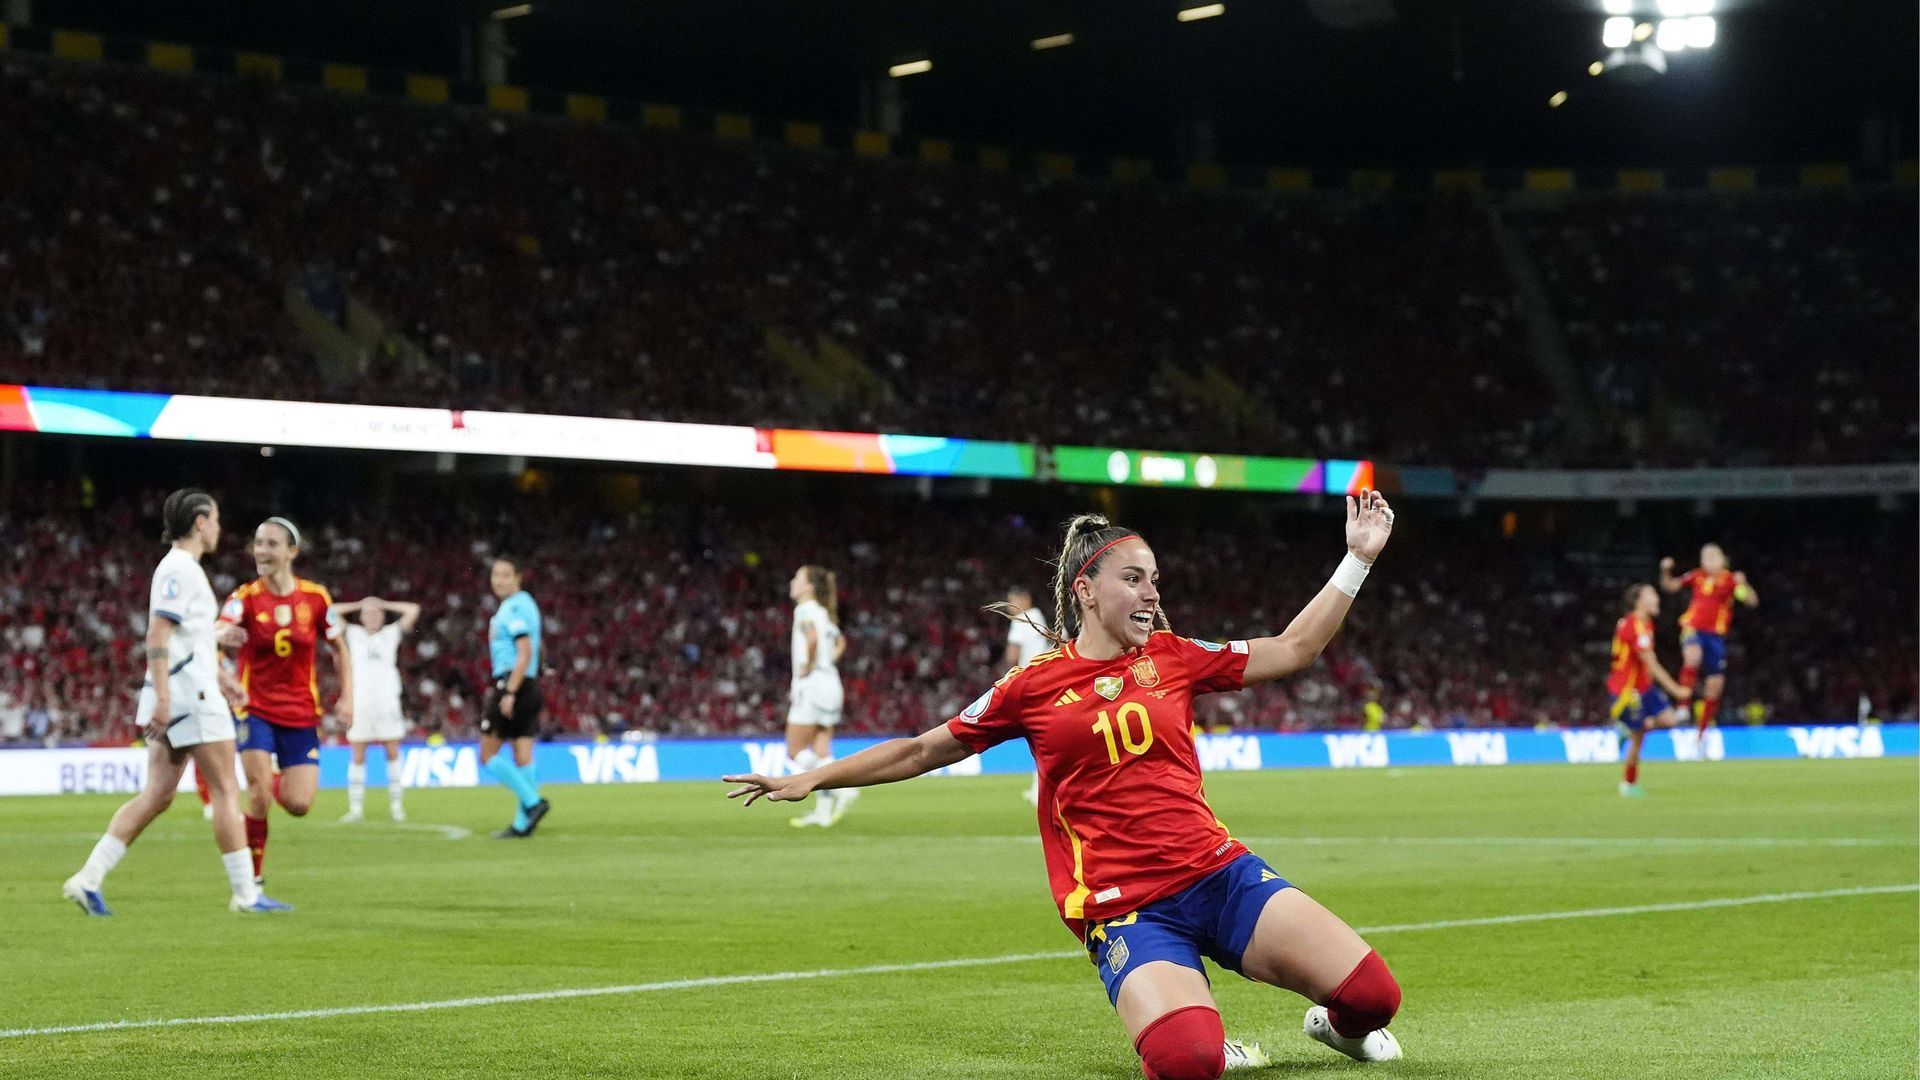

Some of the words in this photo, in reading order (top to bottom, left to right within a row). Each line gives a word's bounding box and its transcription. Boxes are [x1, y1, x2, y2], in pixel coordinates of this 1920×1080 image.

[274, 629, 292, 657] 6
[1091, 702, 1154, 764] 10
[1324, 733, 1390, 767] VISA
[1447, 731, 1508, 765] VISA
[1562, 729, 1620, 763] VISA
[1787, 725, 1884, 758] VISA
[60, 763, 140, 792] BERN
[568, 743, 660, 783] VISA
